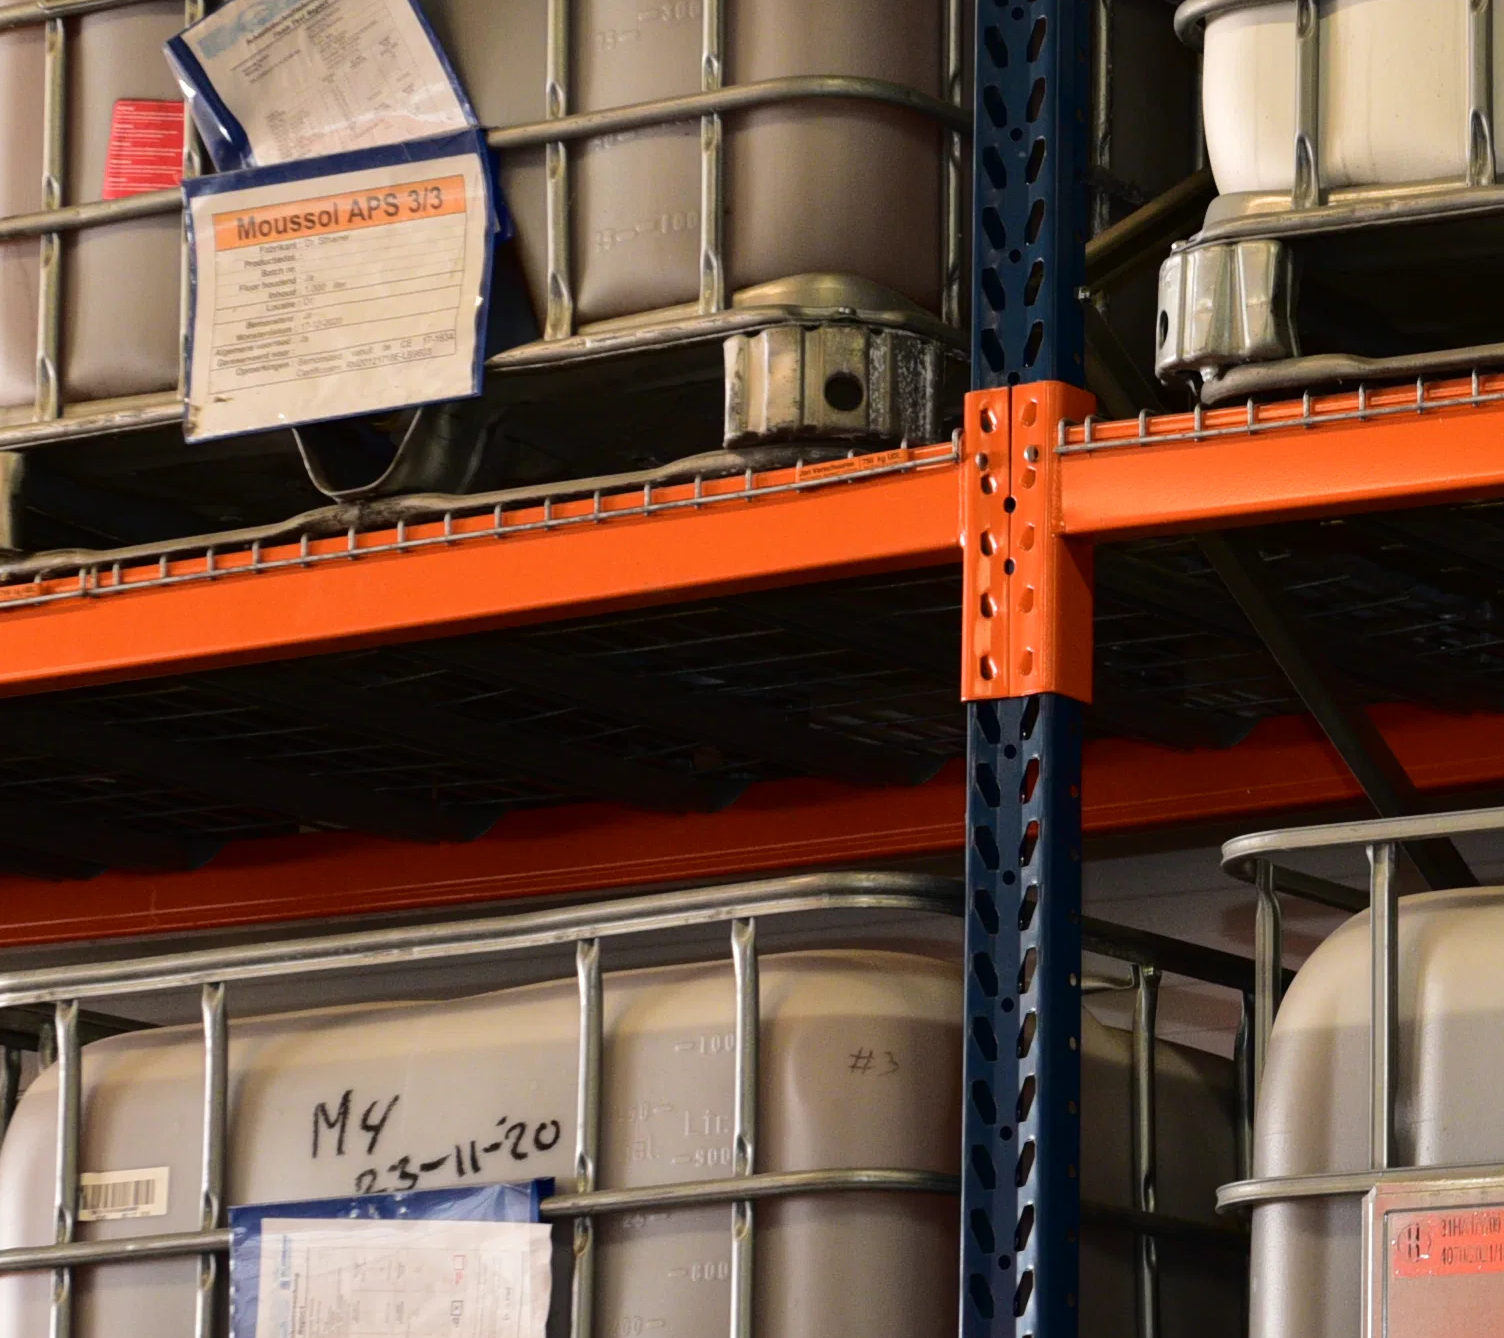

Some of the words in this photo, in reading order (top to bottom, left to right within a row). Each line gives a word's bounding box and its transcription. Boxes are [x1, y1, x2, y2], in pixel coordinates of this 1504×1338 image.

[236, 208, 341, 242] Moussol
[347, 193, 400, 222] APS
[407, 185, 445, 212] 3/3
